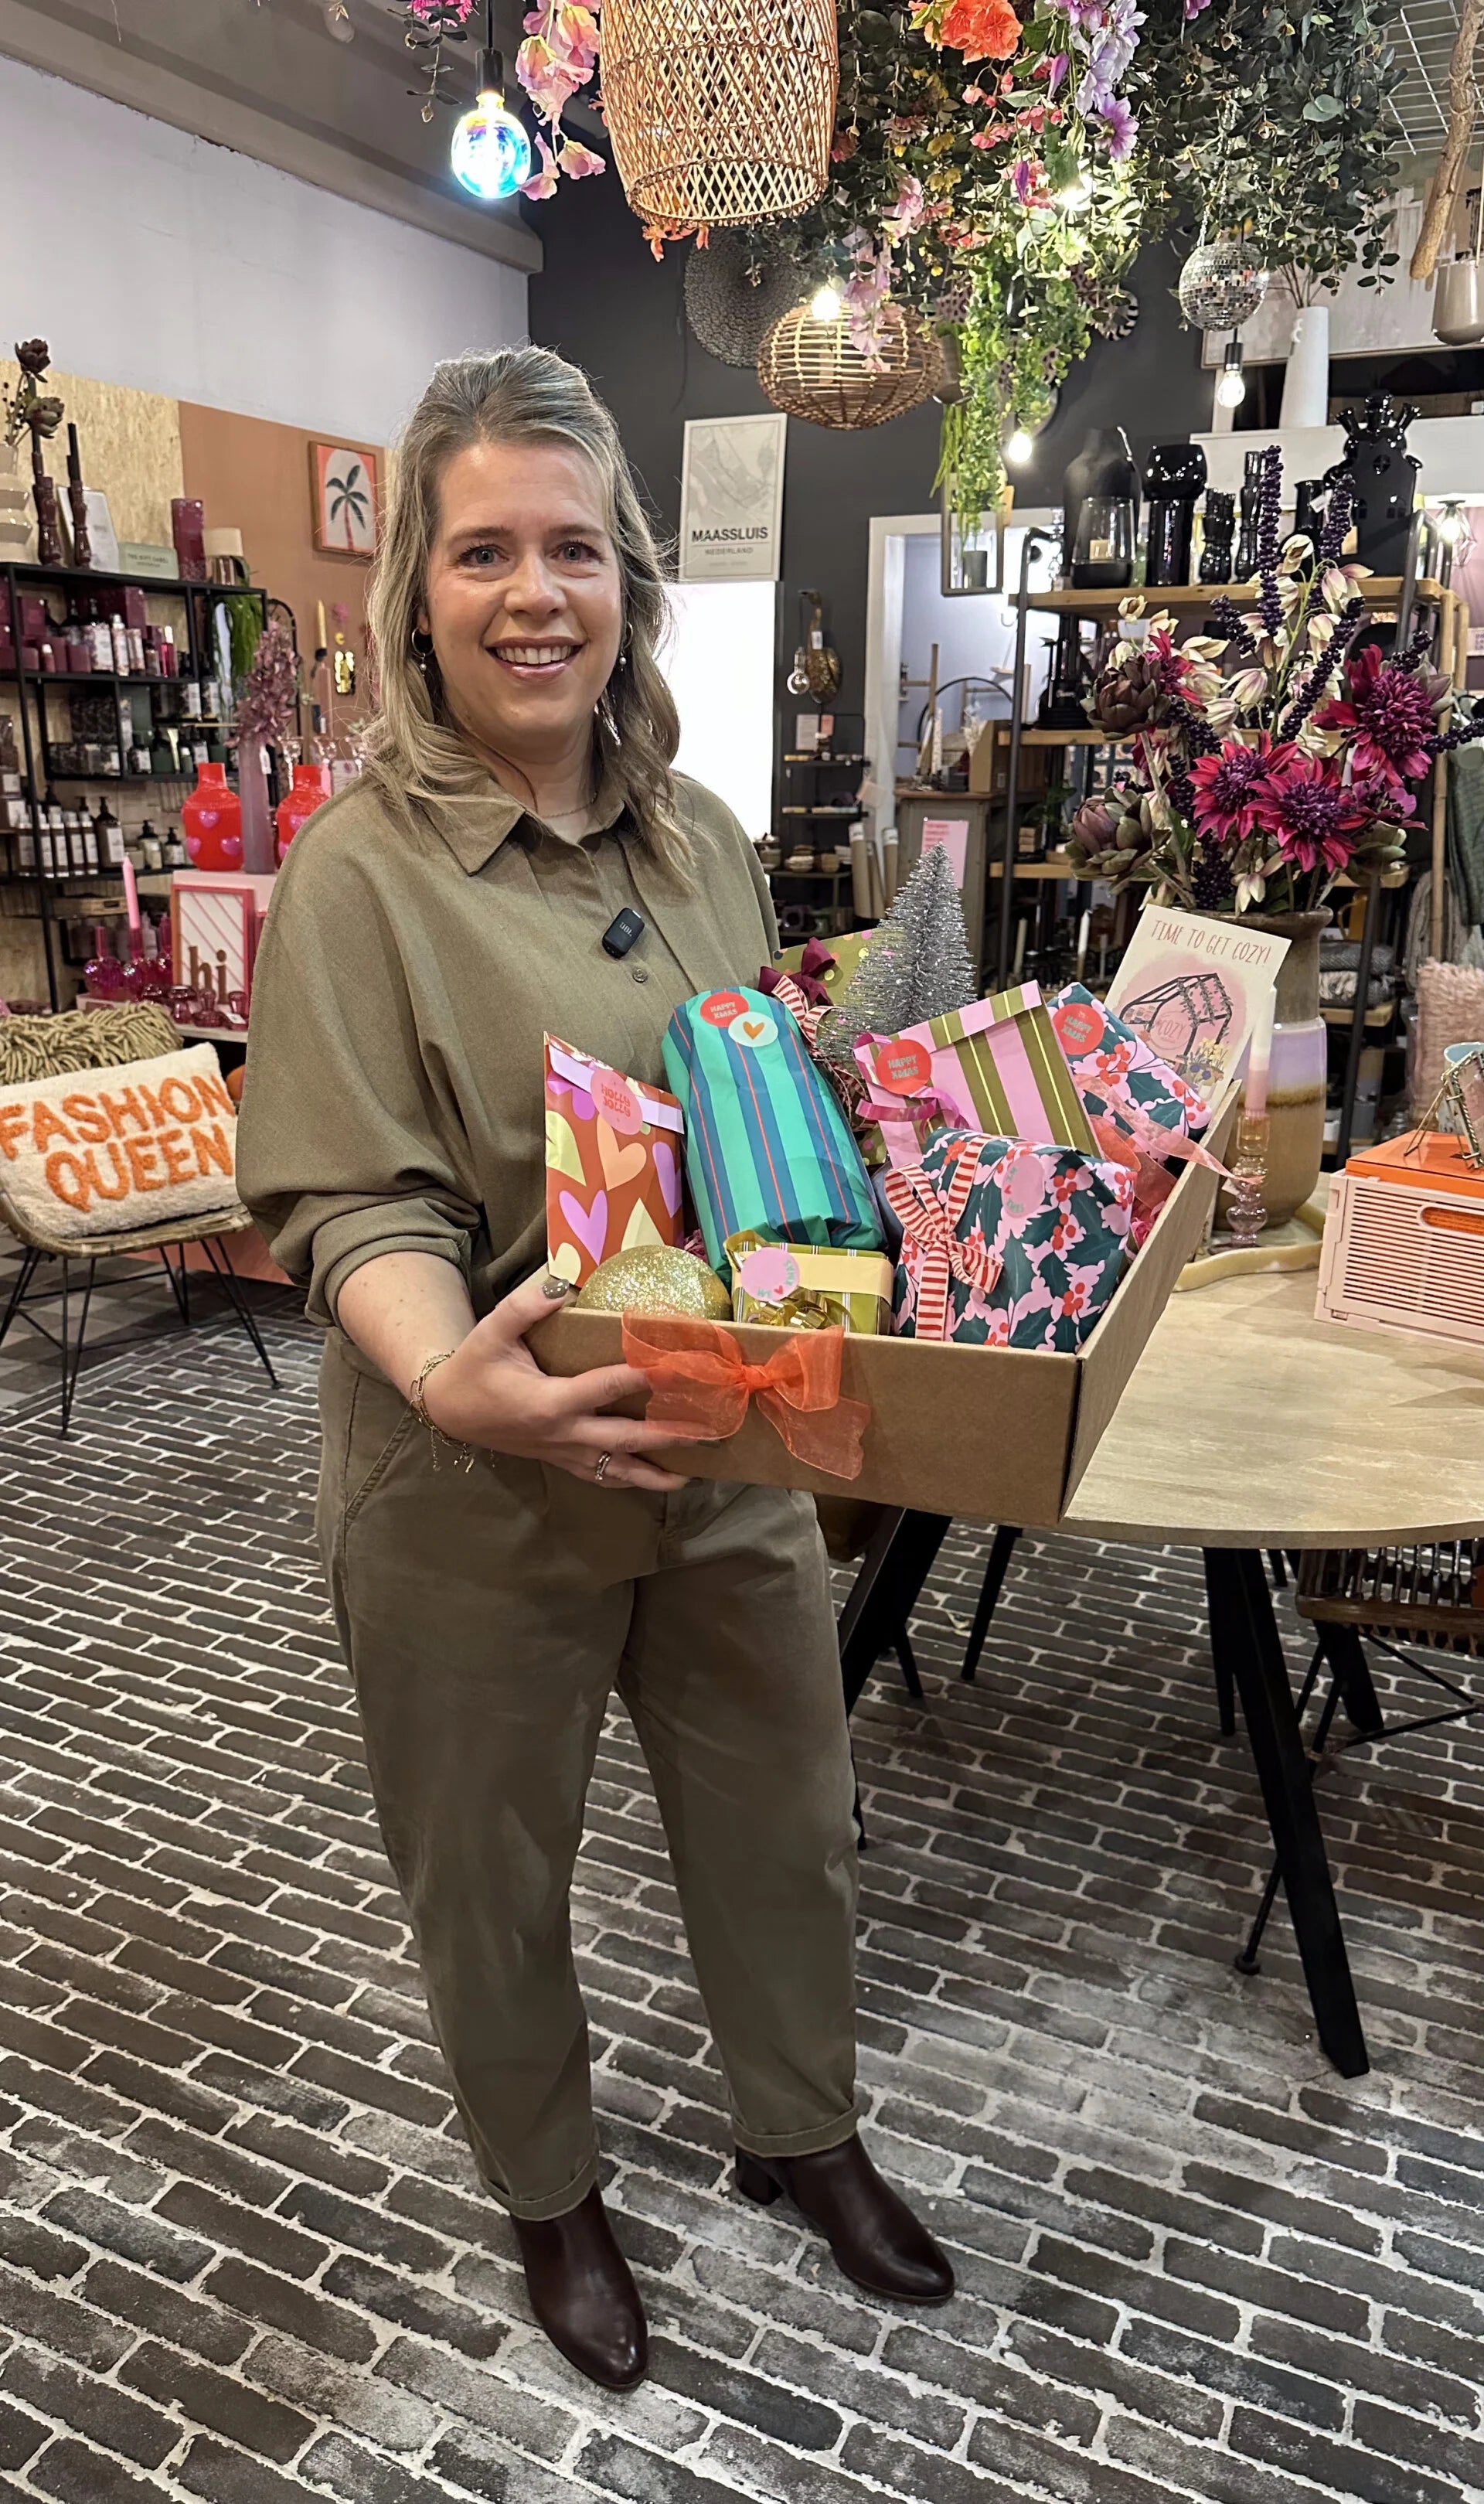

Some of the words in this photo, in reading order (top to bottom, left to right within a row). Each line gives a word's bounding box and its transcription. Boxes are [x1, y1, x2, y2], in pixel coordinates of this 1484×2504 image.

[692, 526, 768, 542] MAASSLUIS
[619, 922, 632, 937] JBL
[1152, 920, 1185, 945] TIME
[1187, 928, 1206, 949] TO
[1206, 935, 1233, 956] GET
[1232, 942, 1271, 967] COZY!
[710, 1001, 736, 1013] HAPPY
[714, 1009, 738, 1020] XMAS
[1066, 1015, 1094, 1034] HAPPY
[1158, 1019, 1188, 1040] COZY
[1062, 1025, 1087, 1043] XMAS
[888, 1054, 917, 1069] HAPPY
[892, 1066, 919, 1080] XMAS
[601, 1083, 631, 1108] HOLLY
[603, 1096, 631, 1118] JOLLY
[0, 1074, 236, 1160] FASHION
[46, 1123, 233, 1213] QUEEN
